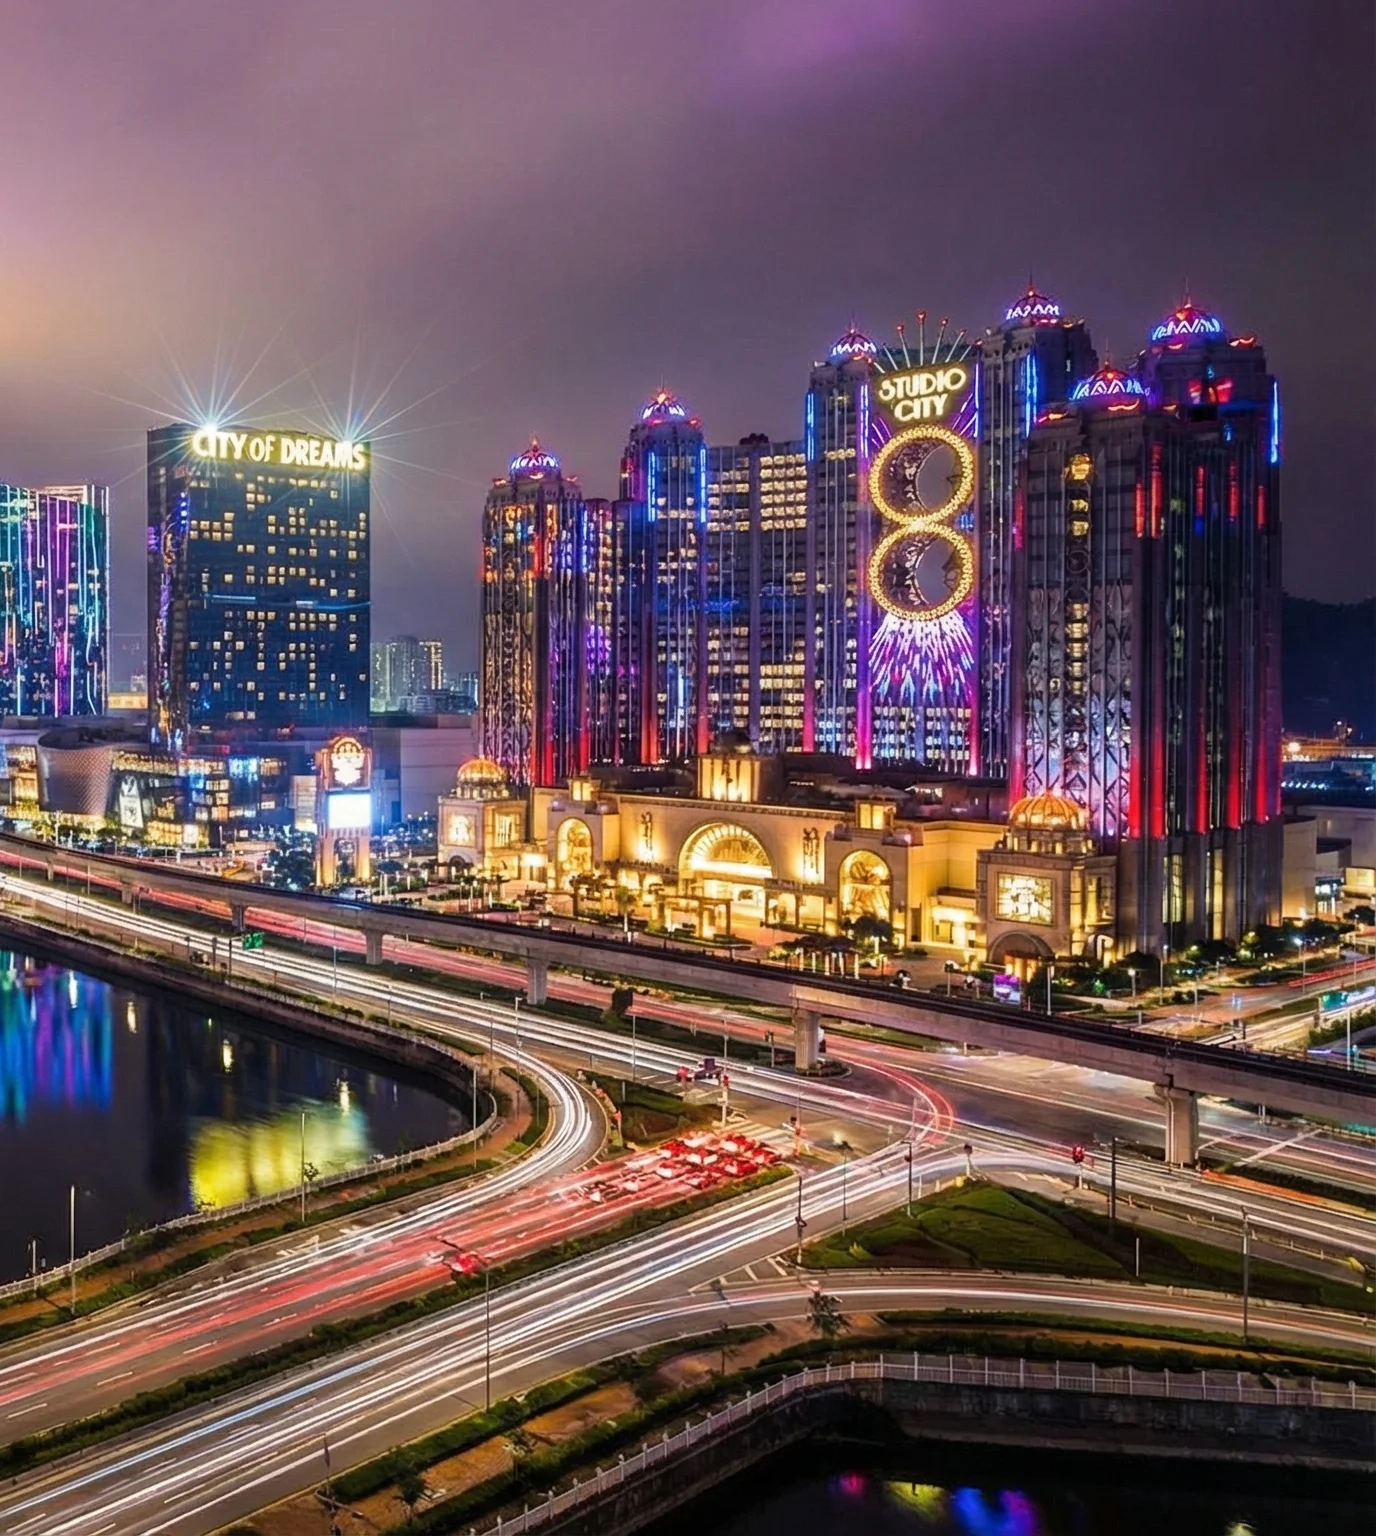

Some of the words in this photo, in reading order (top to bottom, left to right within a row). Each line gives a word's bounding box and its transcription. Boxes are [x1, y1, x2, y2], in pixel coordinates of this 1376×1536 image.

[879, 368, 966, 400] STUDIO
[894, 393, 948, 421] CITY
[192, 430, 248, 460] CITY
[249, 435, 276, 462] OF
[280, 437, 366, 470] DREAMS
